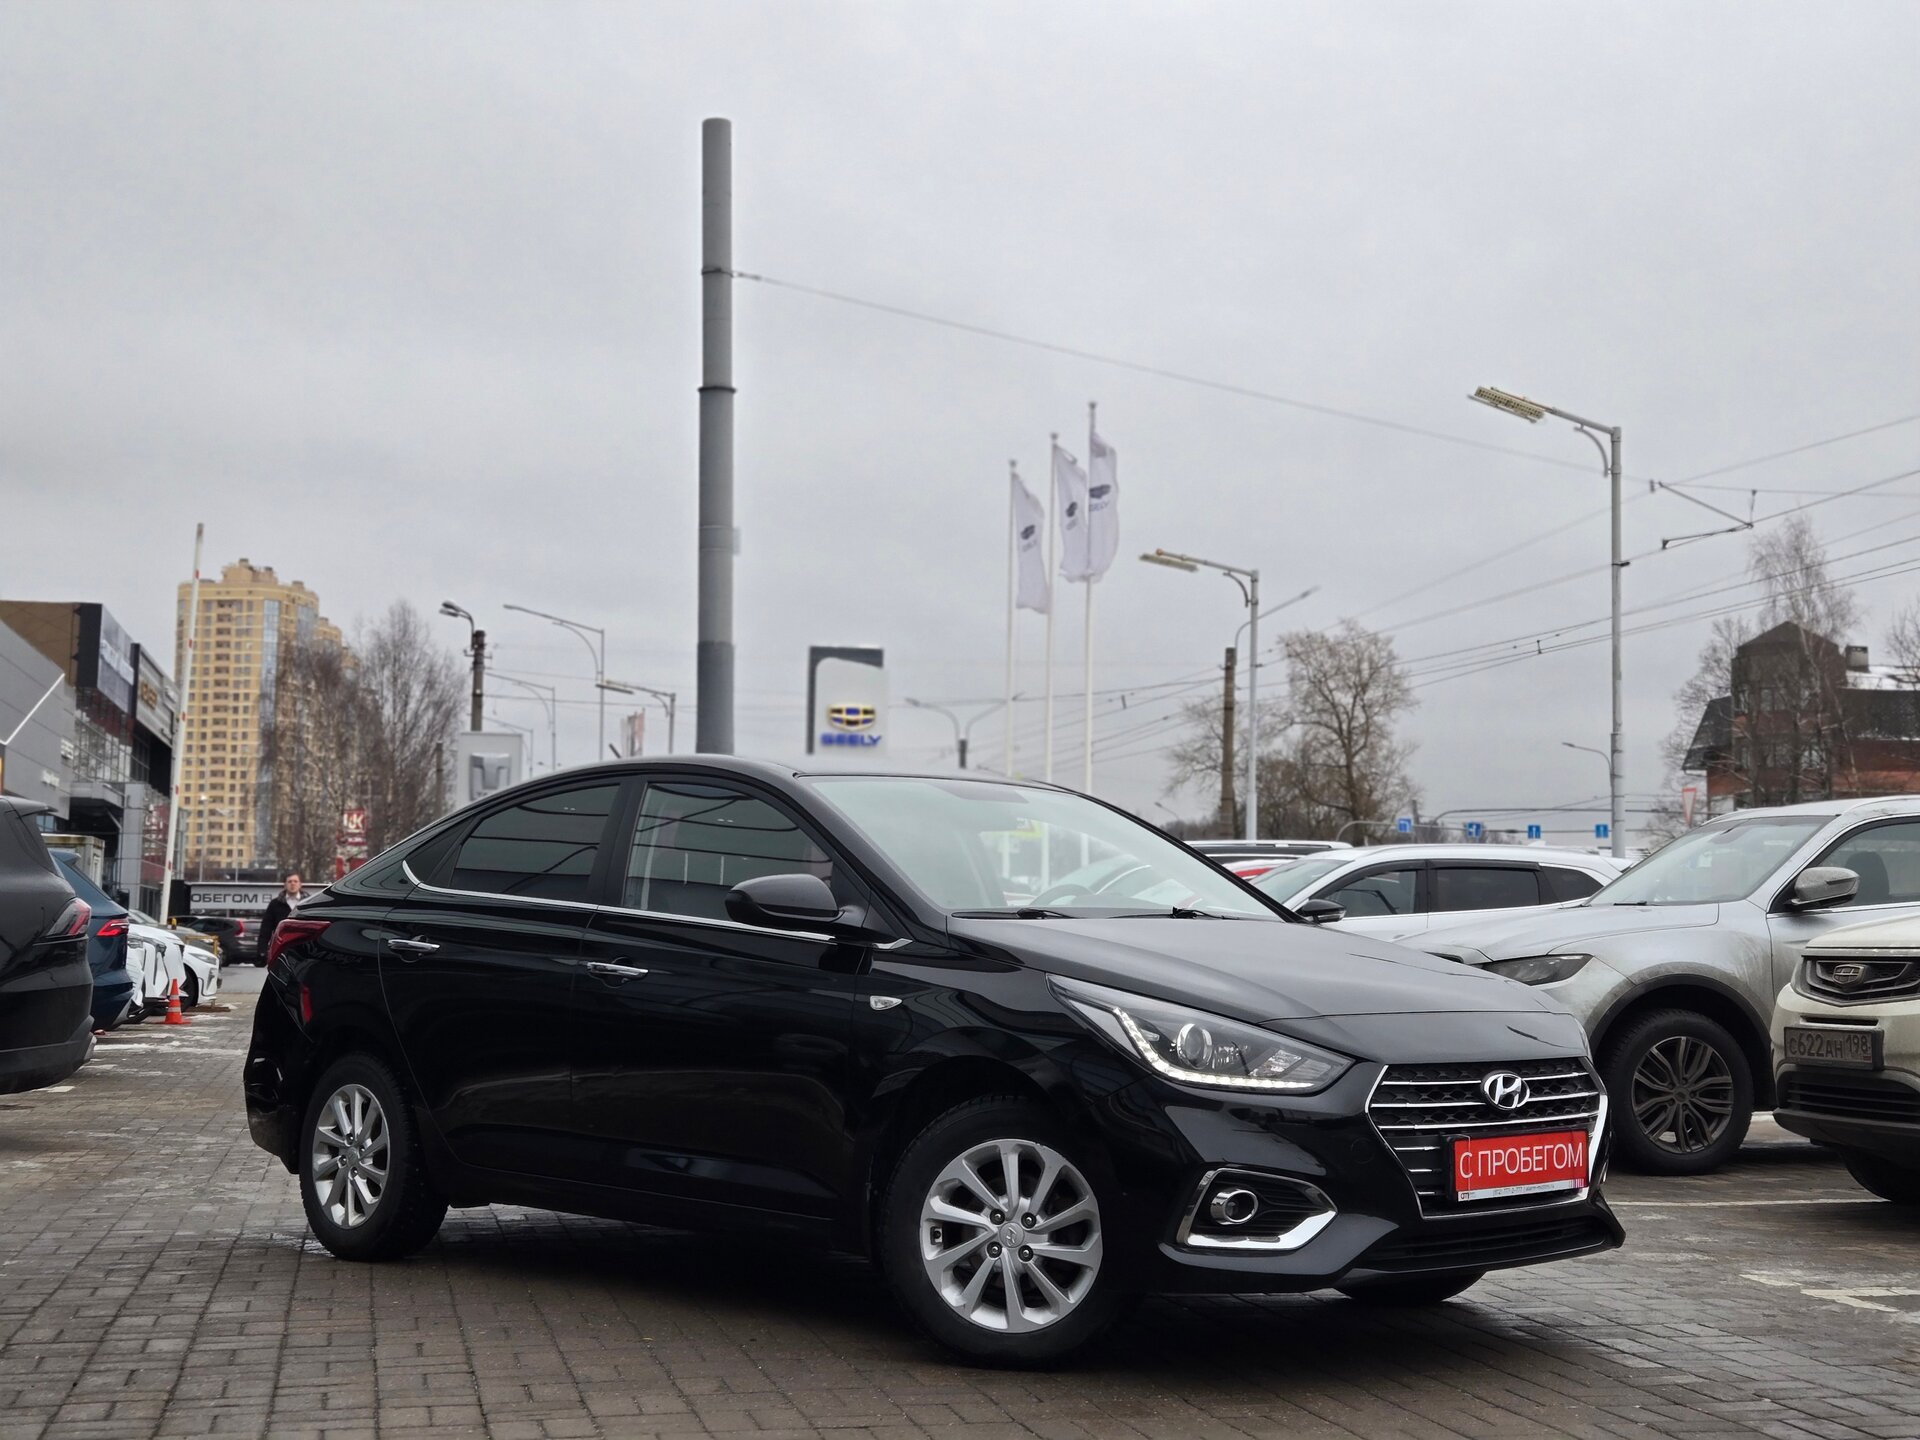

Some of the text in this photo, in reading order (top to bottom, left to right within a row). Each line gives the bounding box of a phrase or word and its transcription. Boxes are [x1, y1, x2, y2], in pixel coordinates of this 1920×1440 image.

[1845, 1034, 1868, 1053] 198
[1459, 1142, 1583, 1179] С ПРОБЕГОМ
